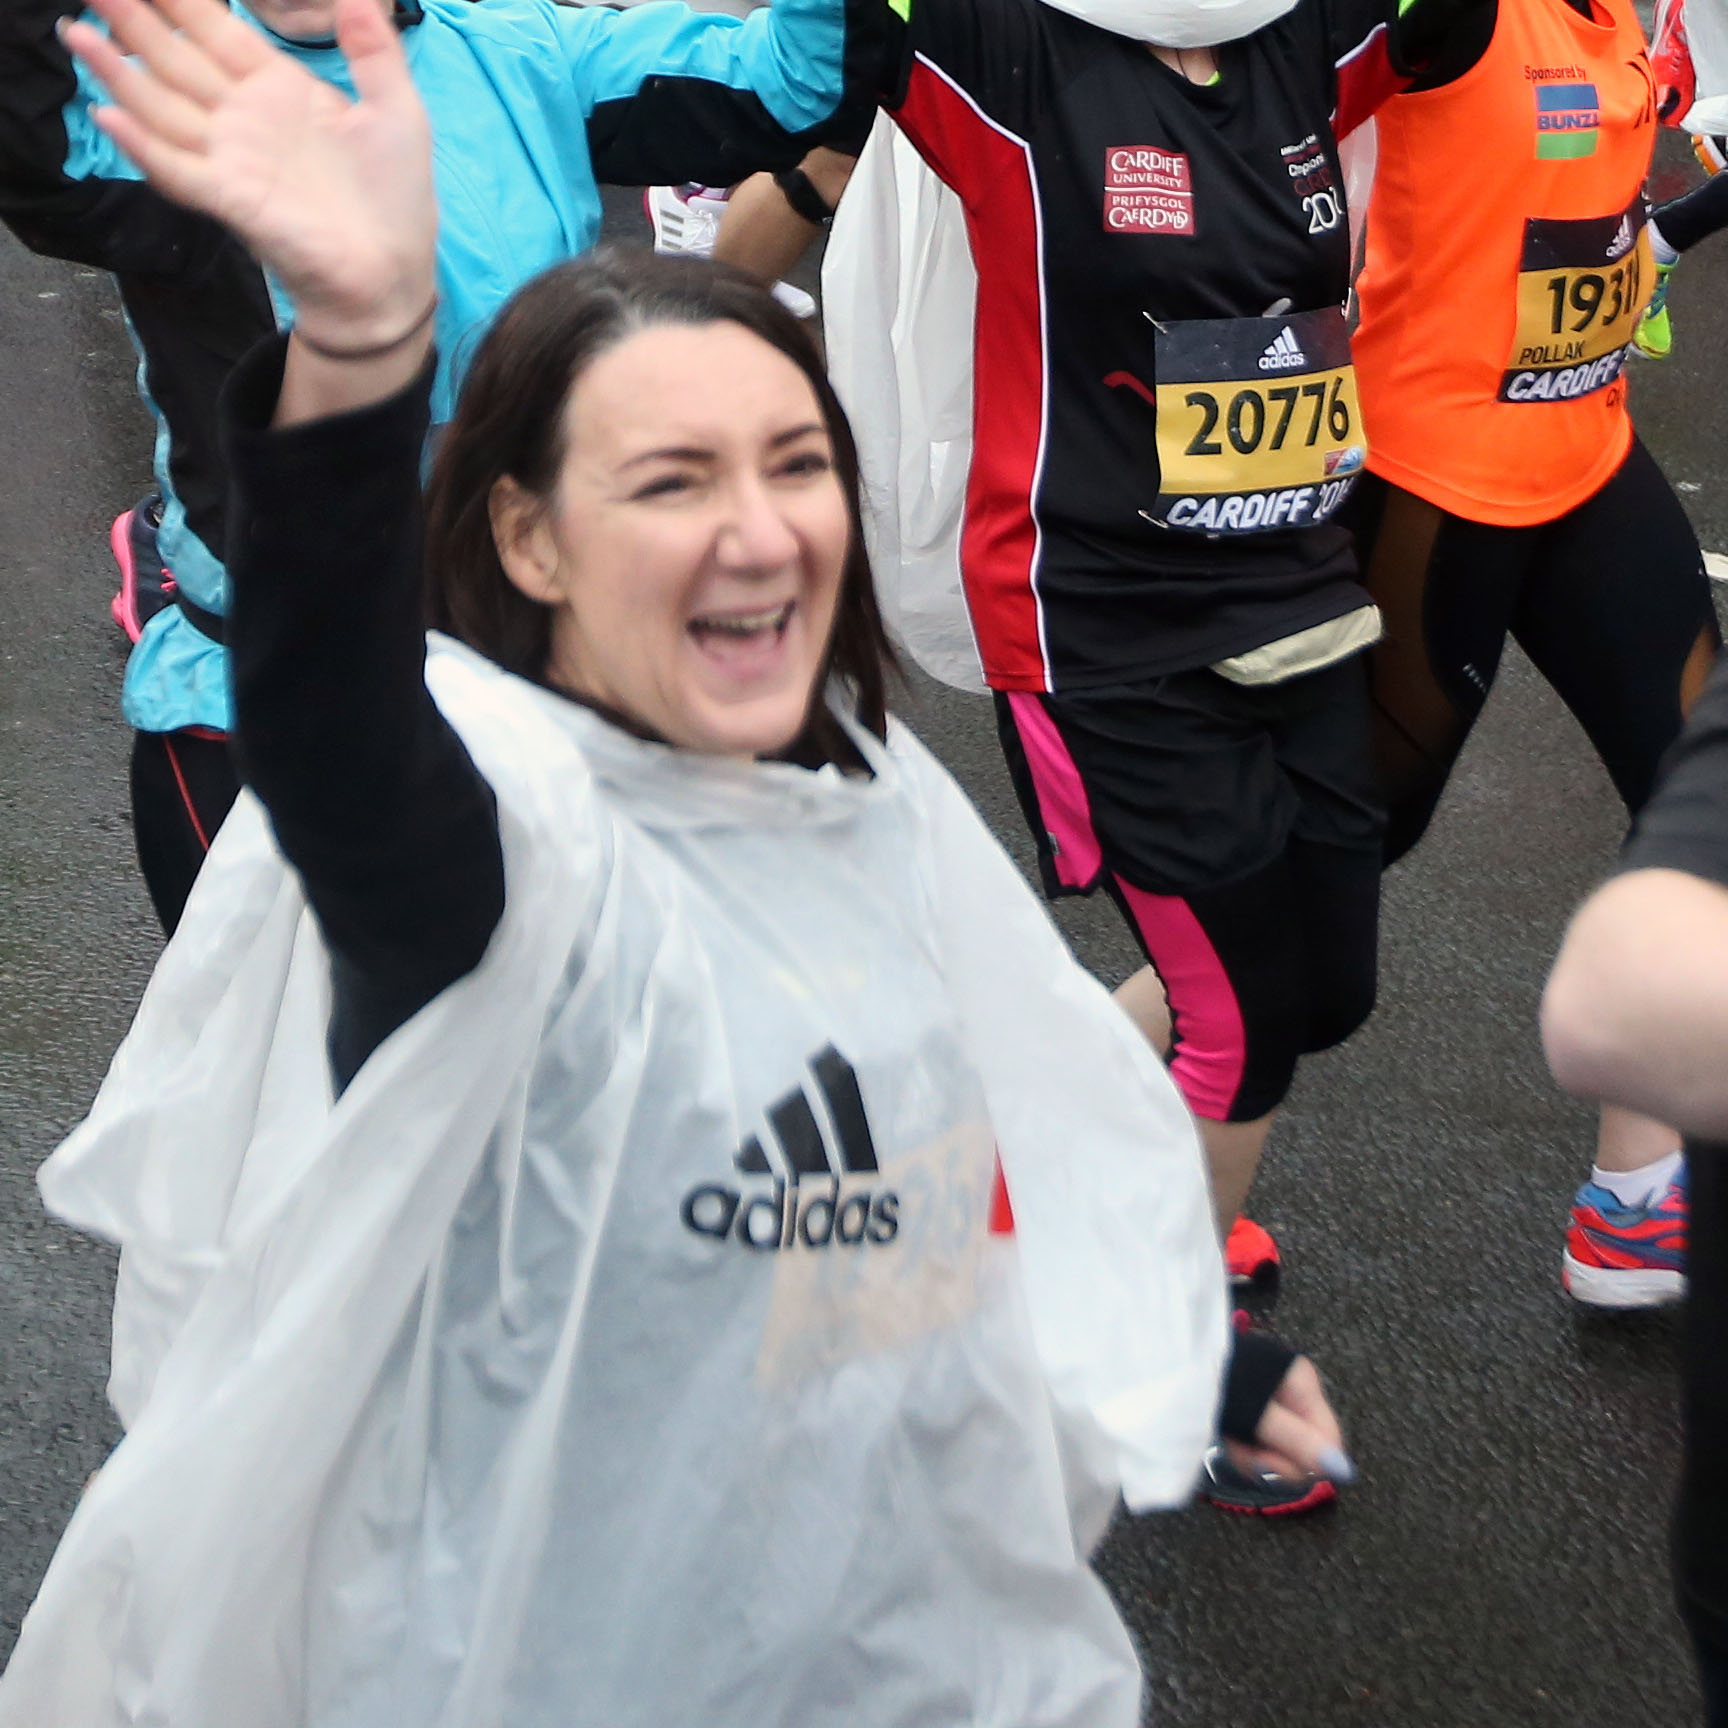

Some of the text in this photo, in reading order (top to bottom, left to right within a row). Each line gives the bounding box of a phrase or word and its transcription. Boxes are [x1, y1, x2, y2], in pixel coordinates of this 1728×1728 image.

[1524, 63, 1569, 81] Sponsored
[1110, 150, 1185, 176] CARDIFF
[1112, 172, 1185, 188] UNIVERSITY
[1112, 194, 1186, 209] PRIFYSGOL
[1258, 352, 1306, 371] adidas
[1518, 340, 1586, 364] POLLAK
[1506, 350, 1624, 401] CARDIFF
[1184, 376, 1350, 457] 20776
[1166, 488, 1309, 530] CARDIFF
[680, 1174, 901, 1252] adidas
